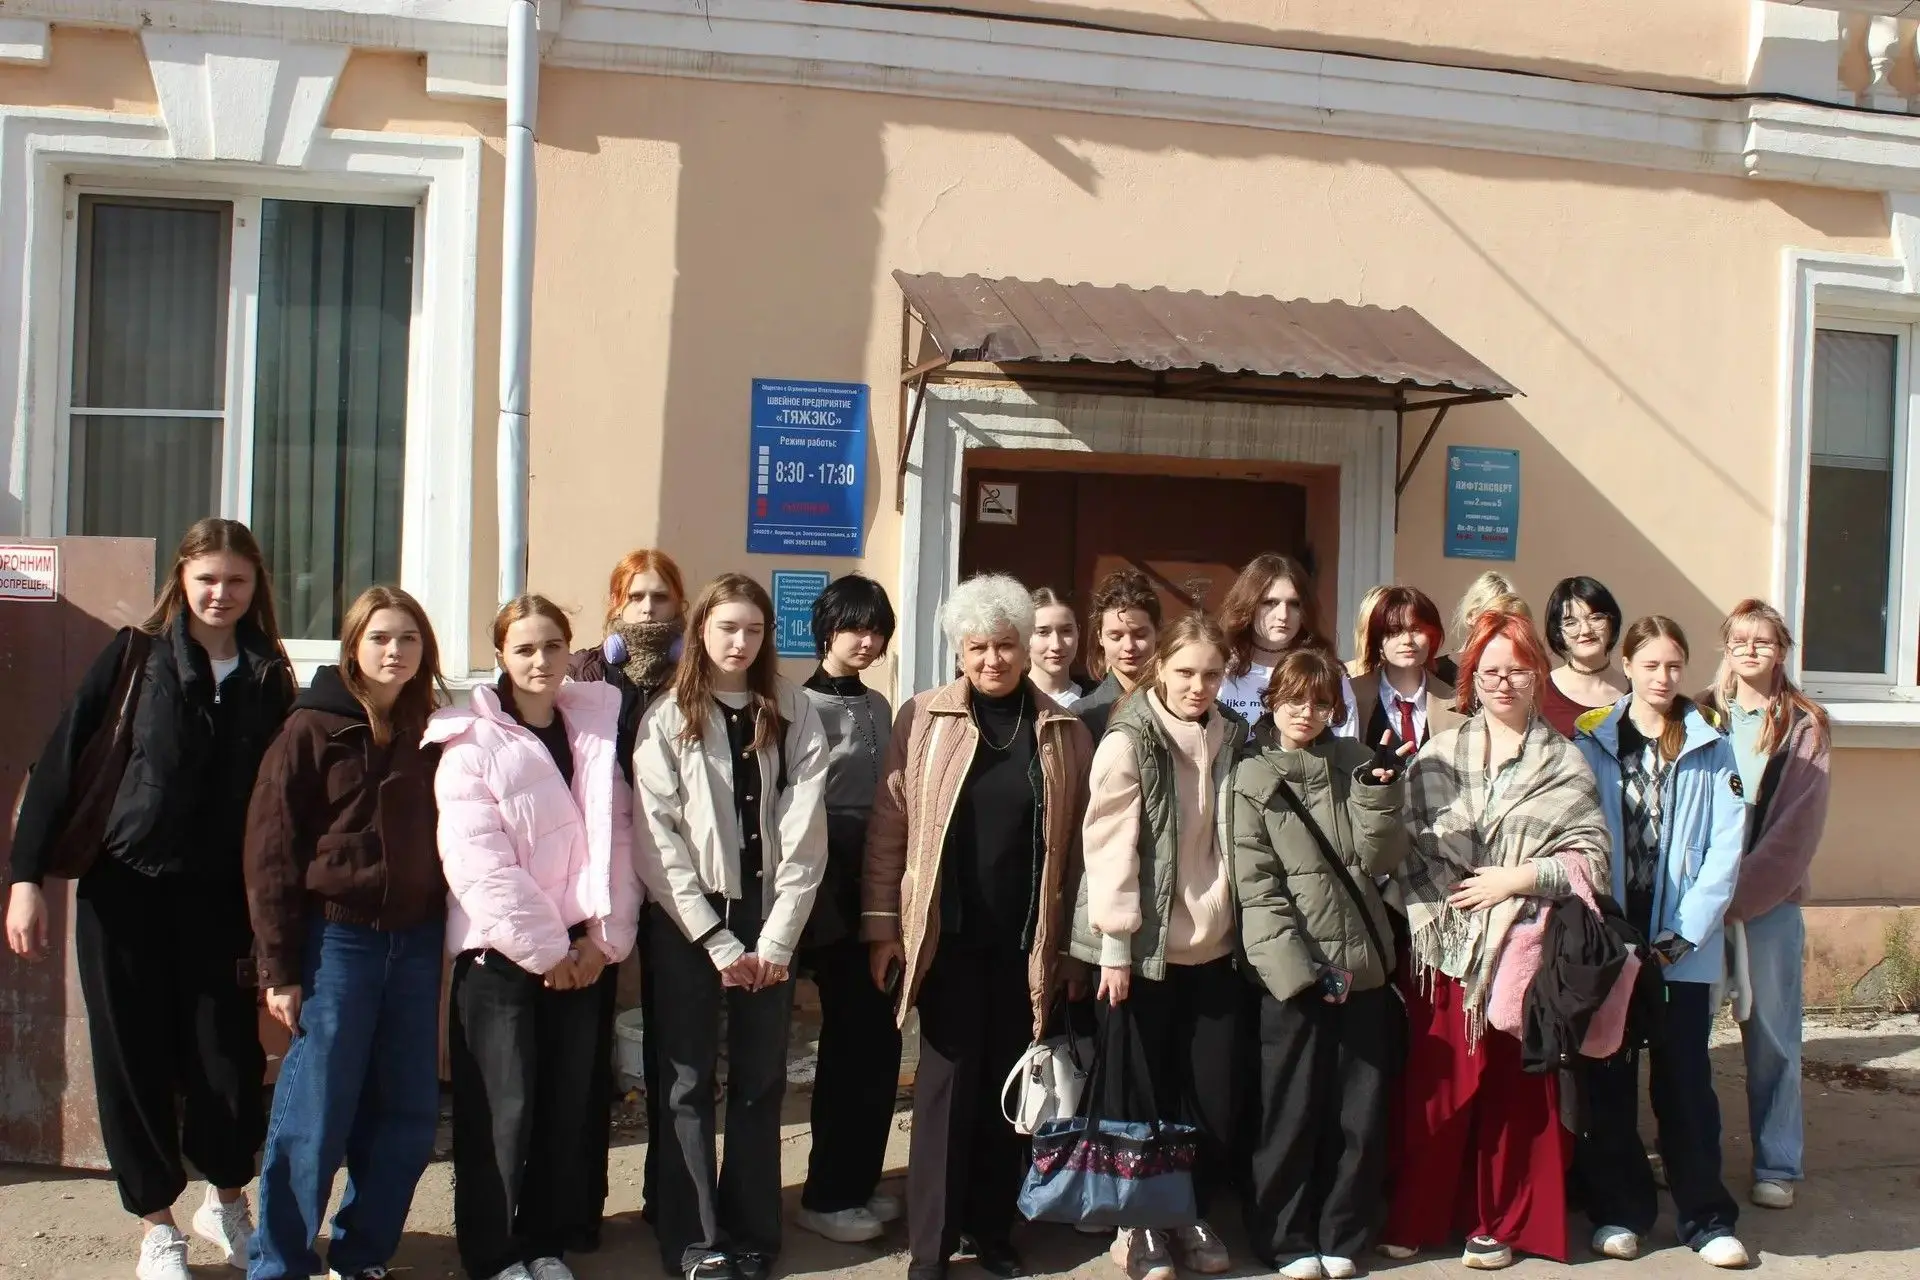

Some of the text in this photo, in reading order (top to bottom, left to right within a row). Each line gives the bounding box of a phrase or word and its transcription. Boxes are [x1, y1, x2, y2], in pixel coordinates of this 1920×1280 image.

[767, 396, 852, 409] ШВЕЙНОЕ ПРЕДПРИЯТИЕ
[776, 409, 842, 426] «ТЯЖЭКС»
[780, 436, 837, 448] Режим работы:
[776, 461, 805, 483] 8:30
[818, 463, 855, 485] 17:30
[782, 597, 814, 605] "Энерги
[791, 619, 812, 636] 10-1
[1226, 699, 1246, 708] like
